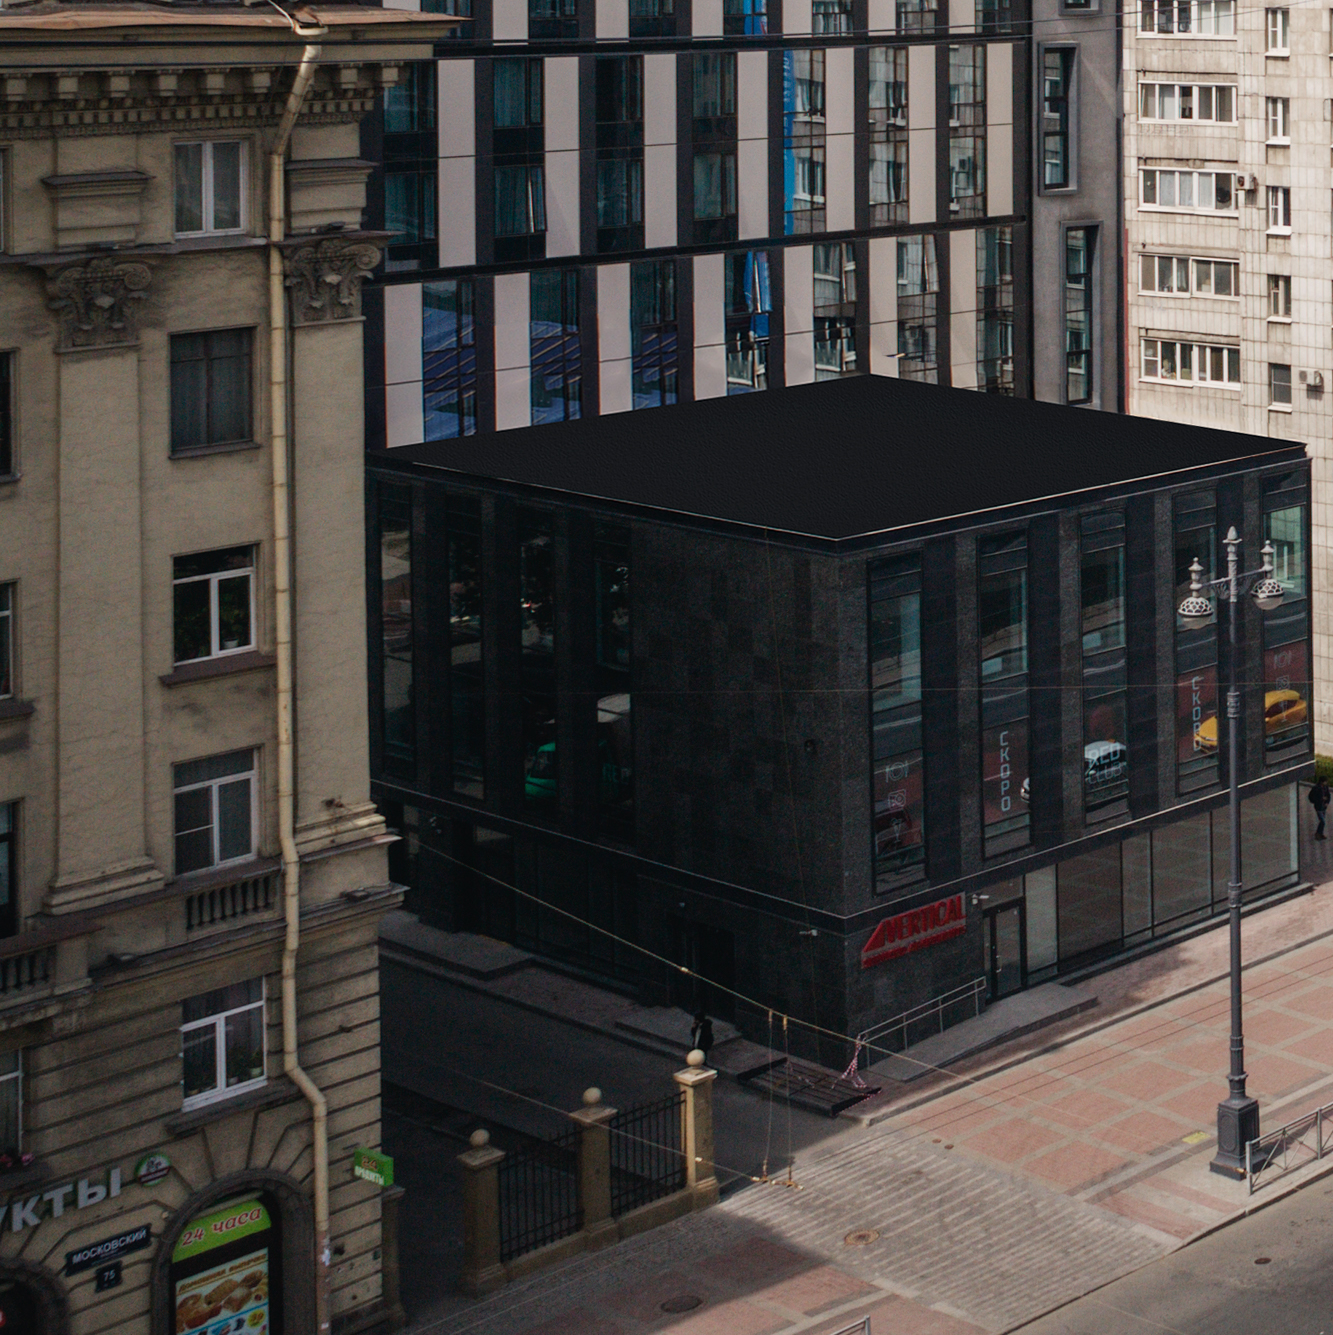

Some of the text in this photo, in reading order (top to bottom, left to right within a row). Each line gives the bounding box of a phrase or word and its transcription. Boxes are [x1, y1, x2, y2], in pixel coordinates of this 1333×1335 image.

[1000, 731, 1011, 812] СКОРО
[181, 1207, 262, 1246] 24 часа
[72, 1228, 147, 1264] МОСКОВСКИЙ
[104, 1269, 116, 1282] 75
